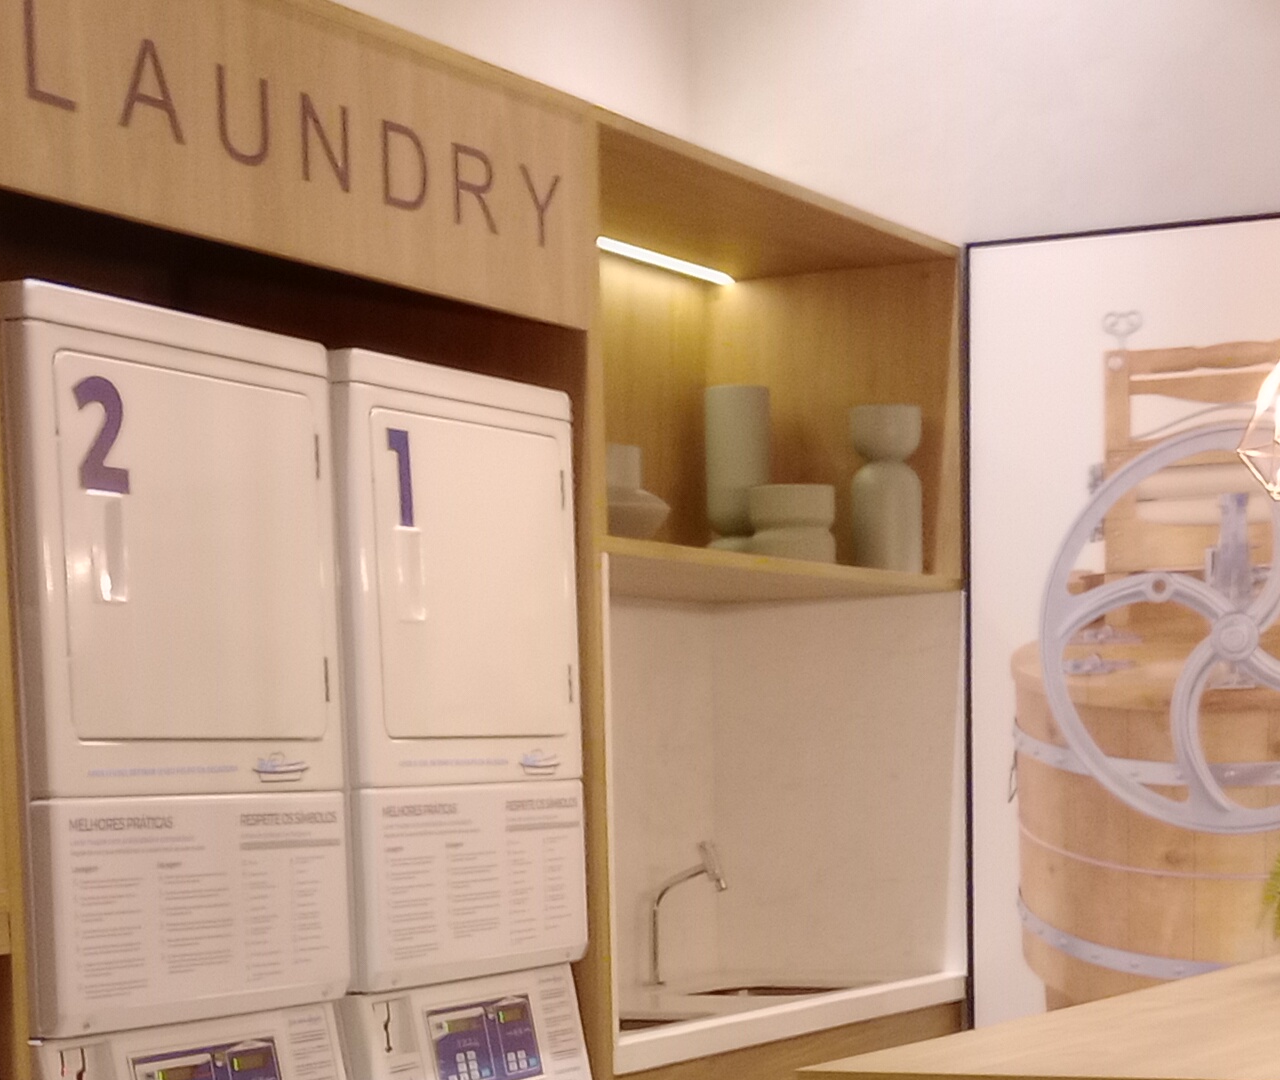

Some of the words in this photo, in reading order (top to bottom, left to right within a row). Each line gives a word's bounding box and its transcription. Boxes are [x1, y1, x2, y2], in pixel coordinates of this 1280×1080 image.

[22, 0, 562, 247] LAUNDRY
[72, 376, 130, 495] 2
[386, 427, 415, 527] 1
